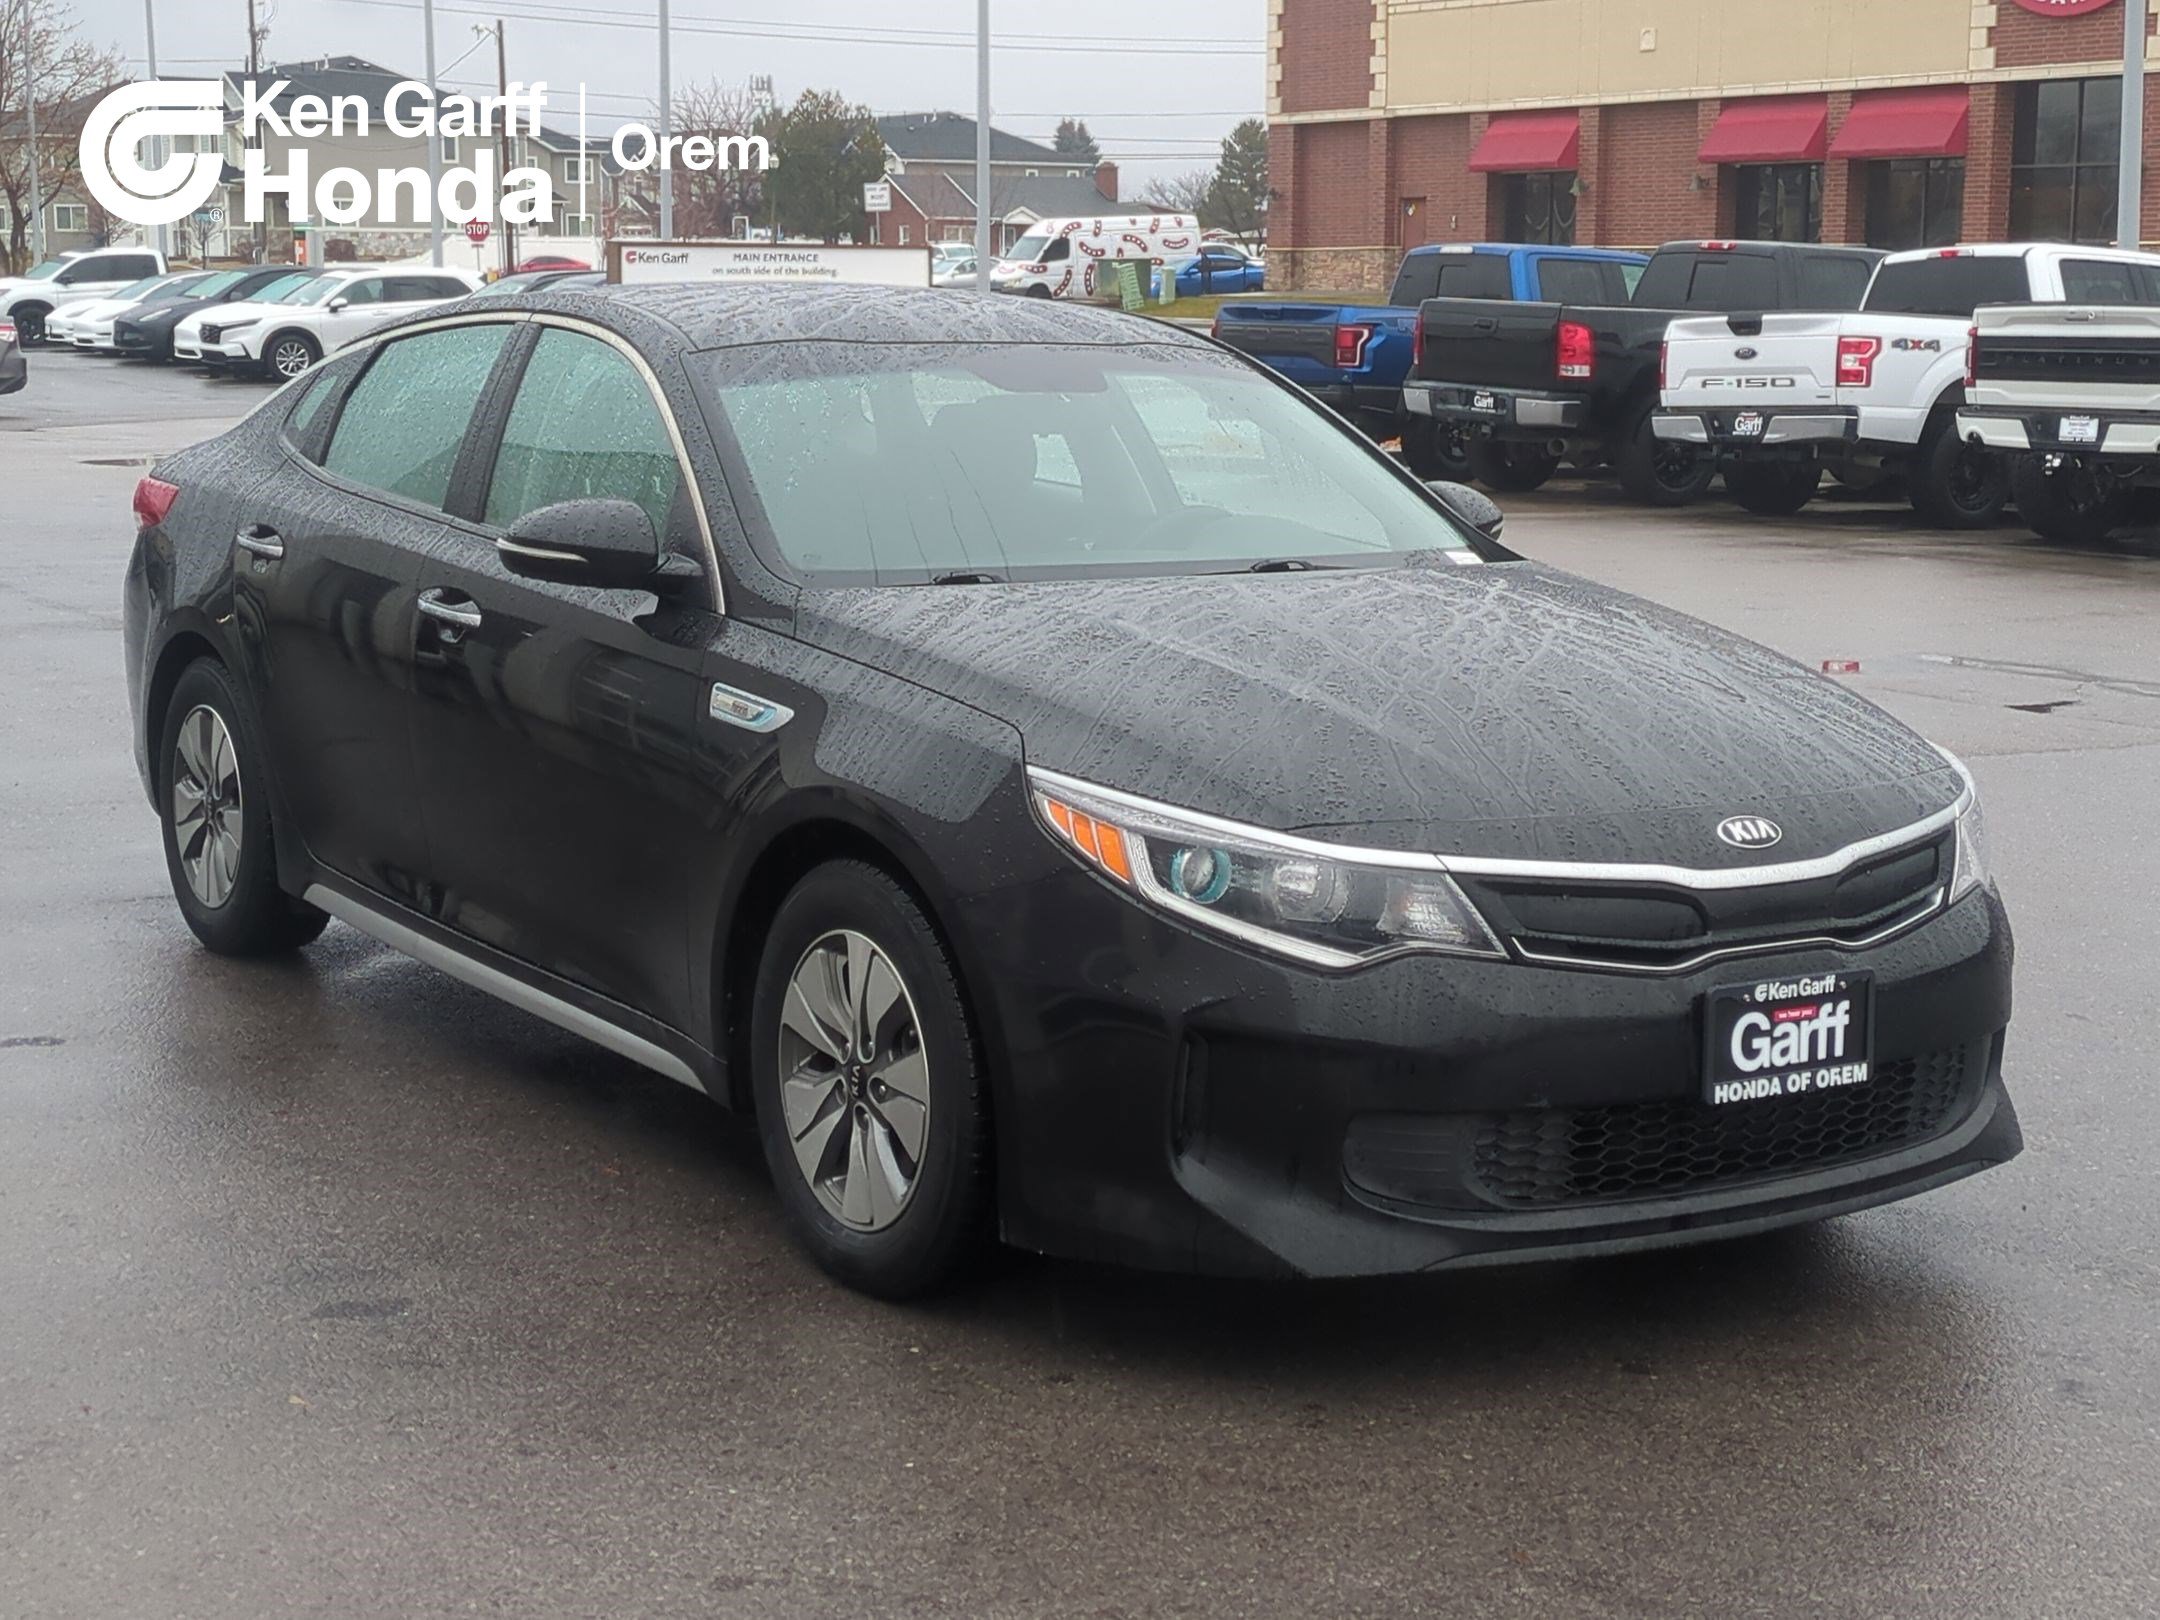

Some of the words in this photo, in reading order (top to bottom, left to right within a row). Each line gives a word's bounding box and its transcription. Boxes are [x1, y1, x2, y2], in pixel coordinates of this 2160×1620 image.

[466, 223, 489, 235] STOP
[638, 252, 660, 263] Ken
[661, 252, 689, 264] Garff
[733, 253, 761, 263] MAIN
[763, 253, 819, 263] ENTRANCE
[726, 266, 752, 275] south
[753, 266, 771, 275] side
[773, 266, 784, 275] of
[784, 266, 800, 275] the
[2005, 355, 2150, 366] PLATINUM
[1701, 376, 1796, 389] F-150
[1734, 415, 1764, 432] Garff
[1725, 819, 1778, 842] KIA
[1768, 981, 1798, 1001] Ken
[1798, 974, 1837, 997] Garff
[1730, 999, 1851, 1073] Garff
[1714, 1076, 1783, 1104] HONDA
[1786, 1071, 1812, 1093] OF
[1815, 1062, 1869, 1089] OREM
